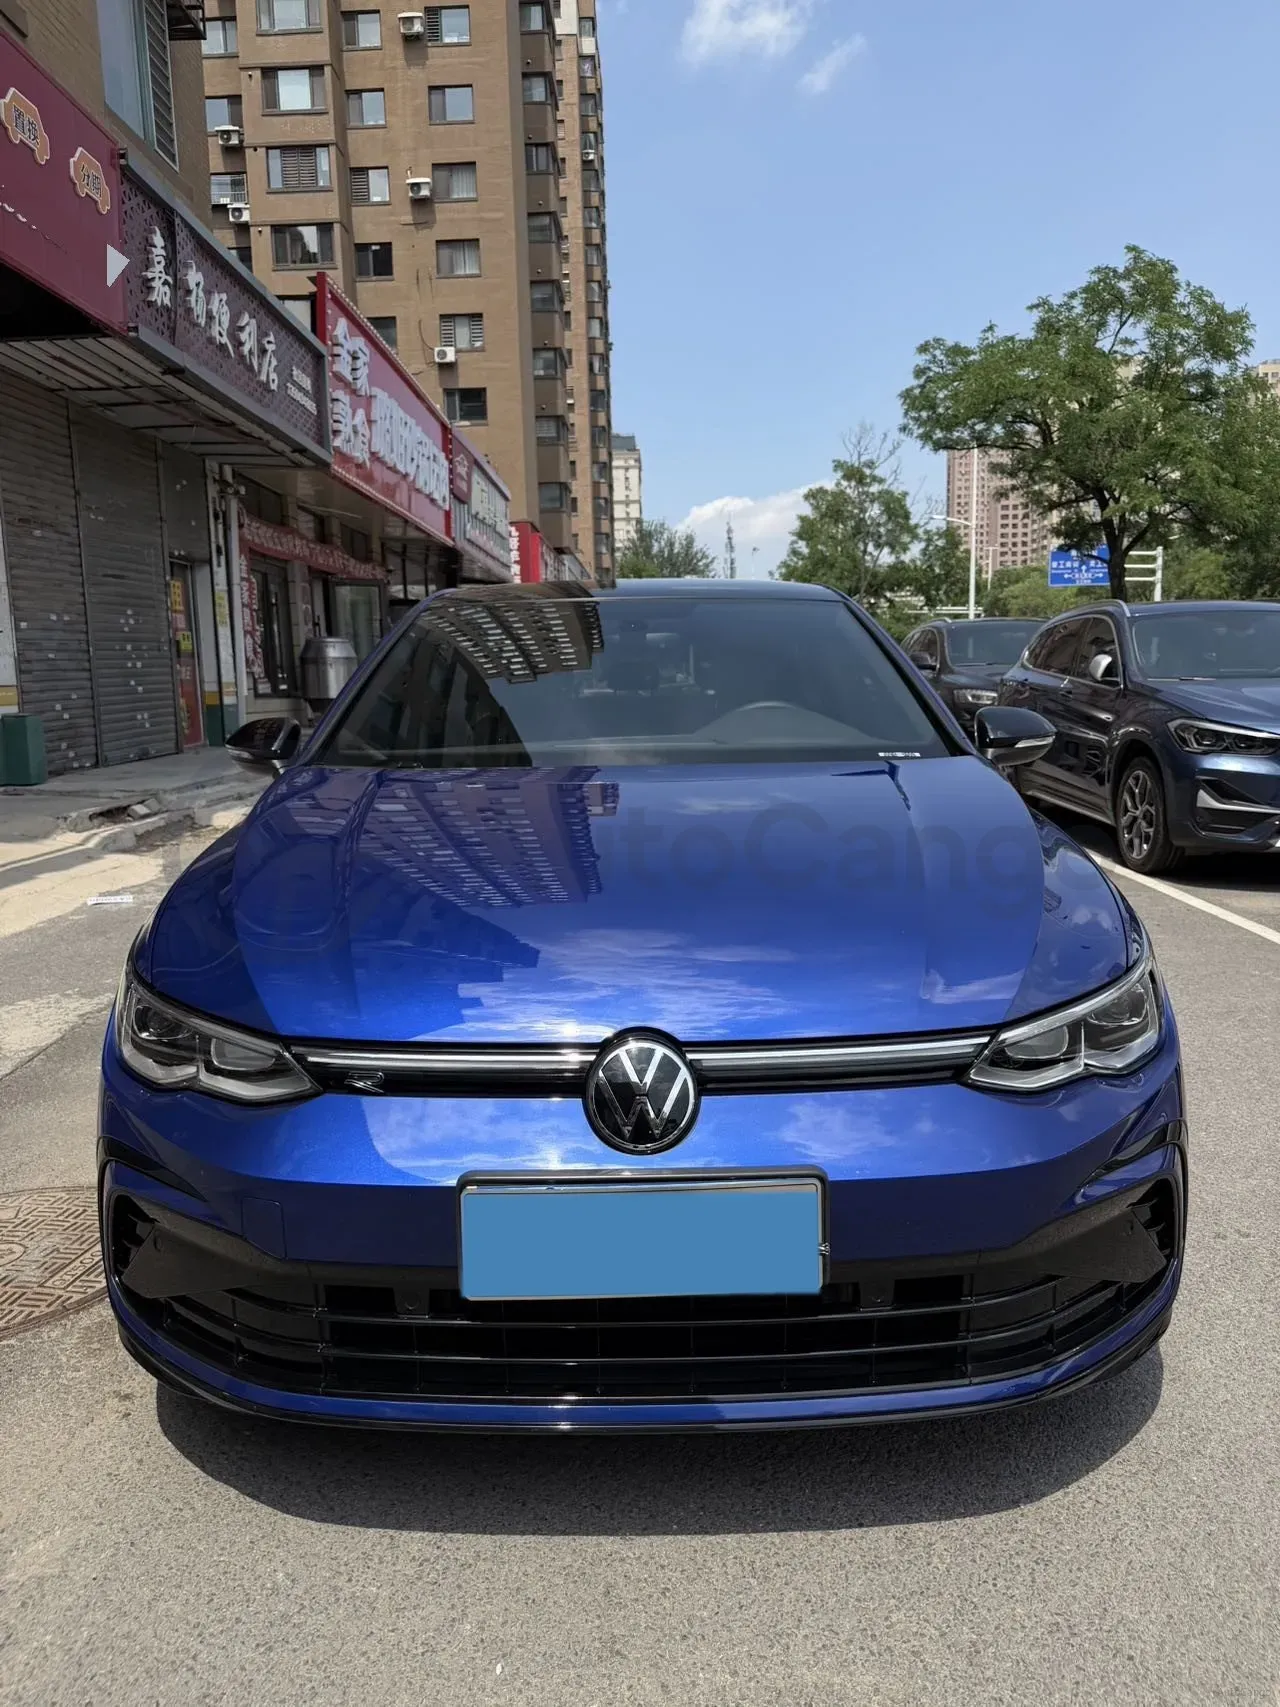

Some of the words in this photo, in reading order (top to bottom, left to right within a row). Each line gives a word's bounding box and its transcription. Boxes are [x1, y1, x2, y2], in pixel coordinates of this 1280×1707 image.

[13, 103, 40, 146] 置换
[80, 163, 103, 198] 分期
[344, 1070, 385, 1094] R
